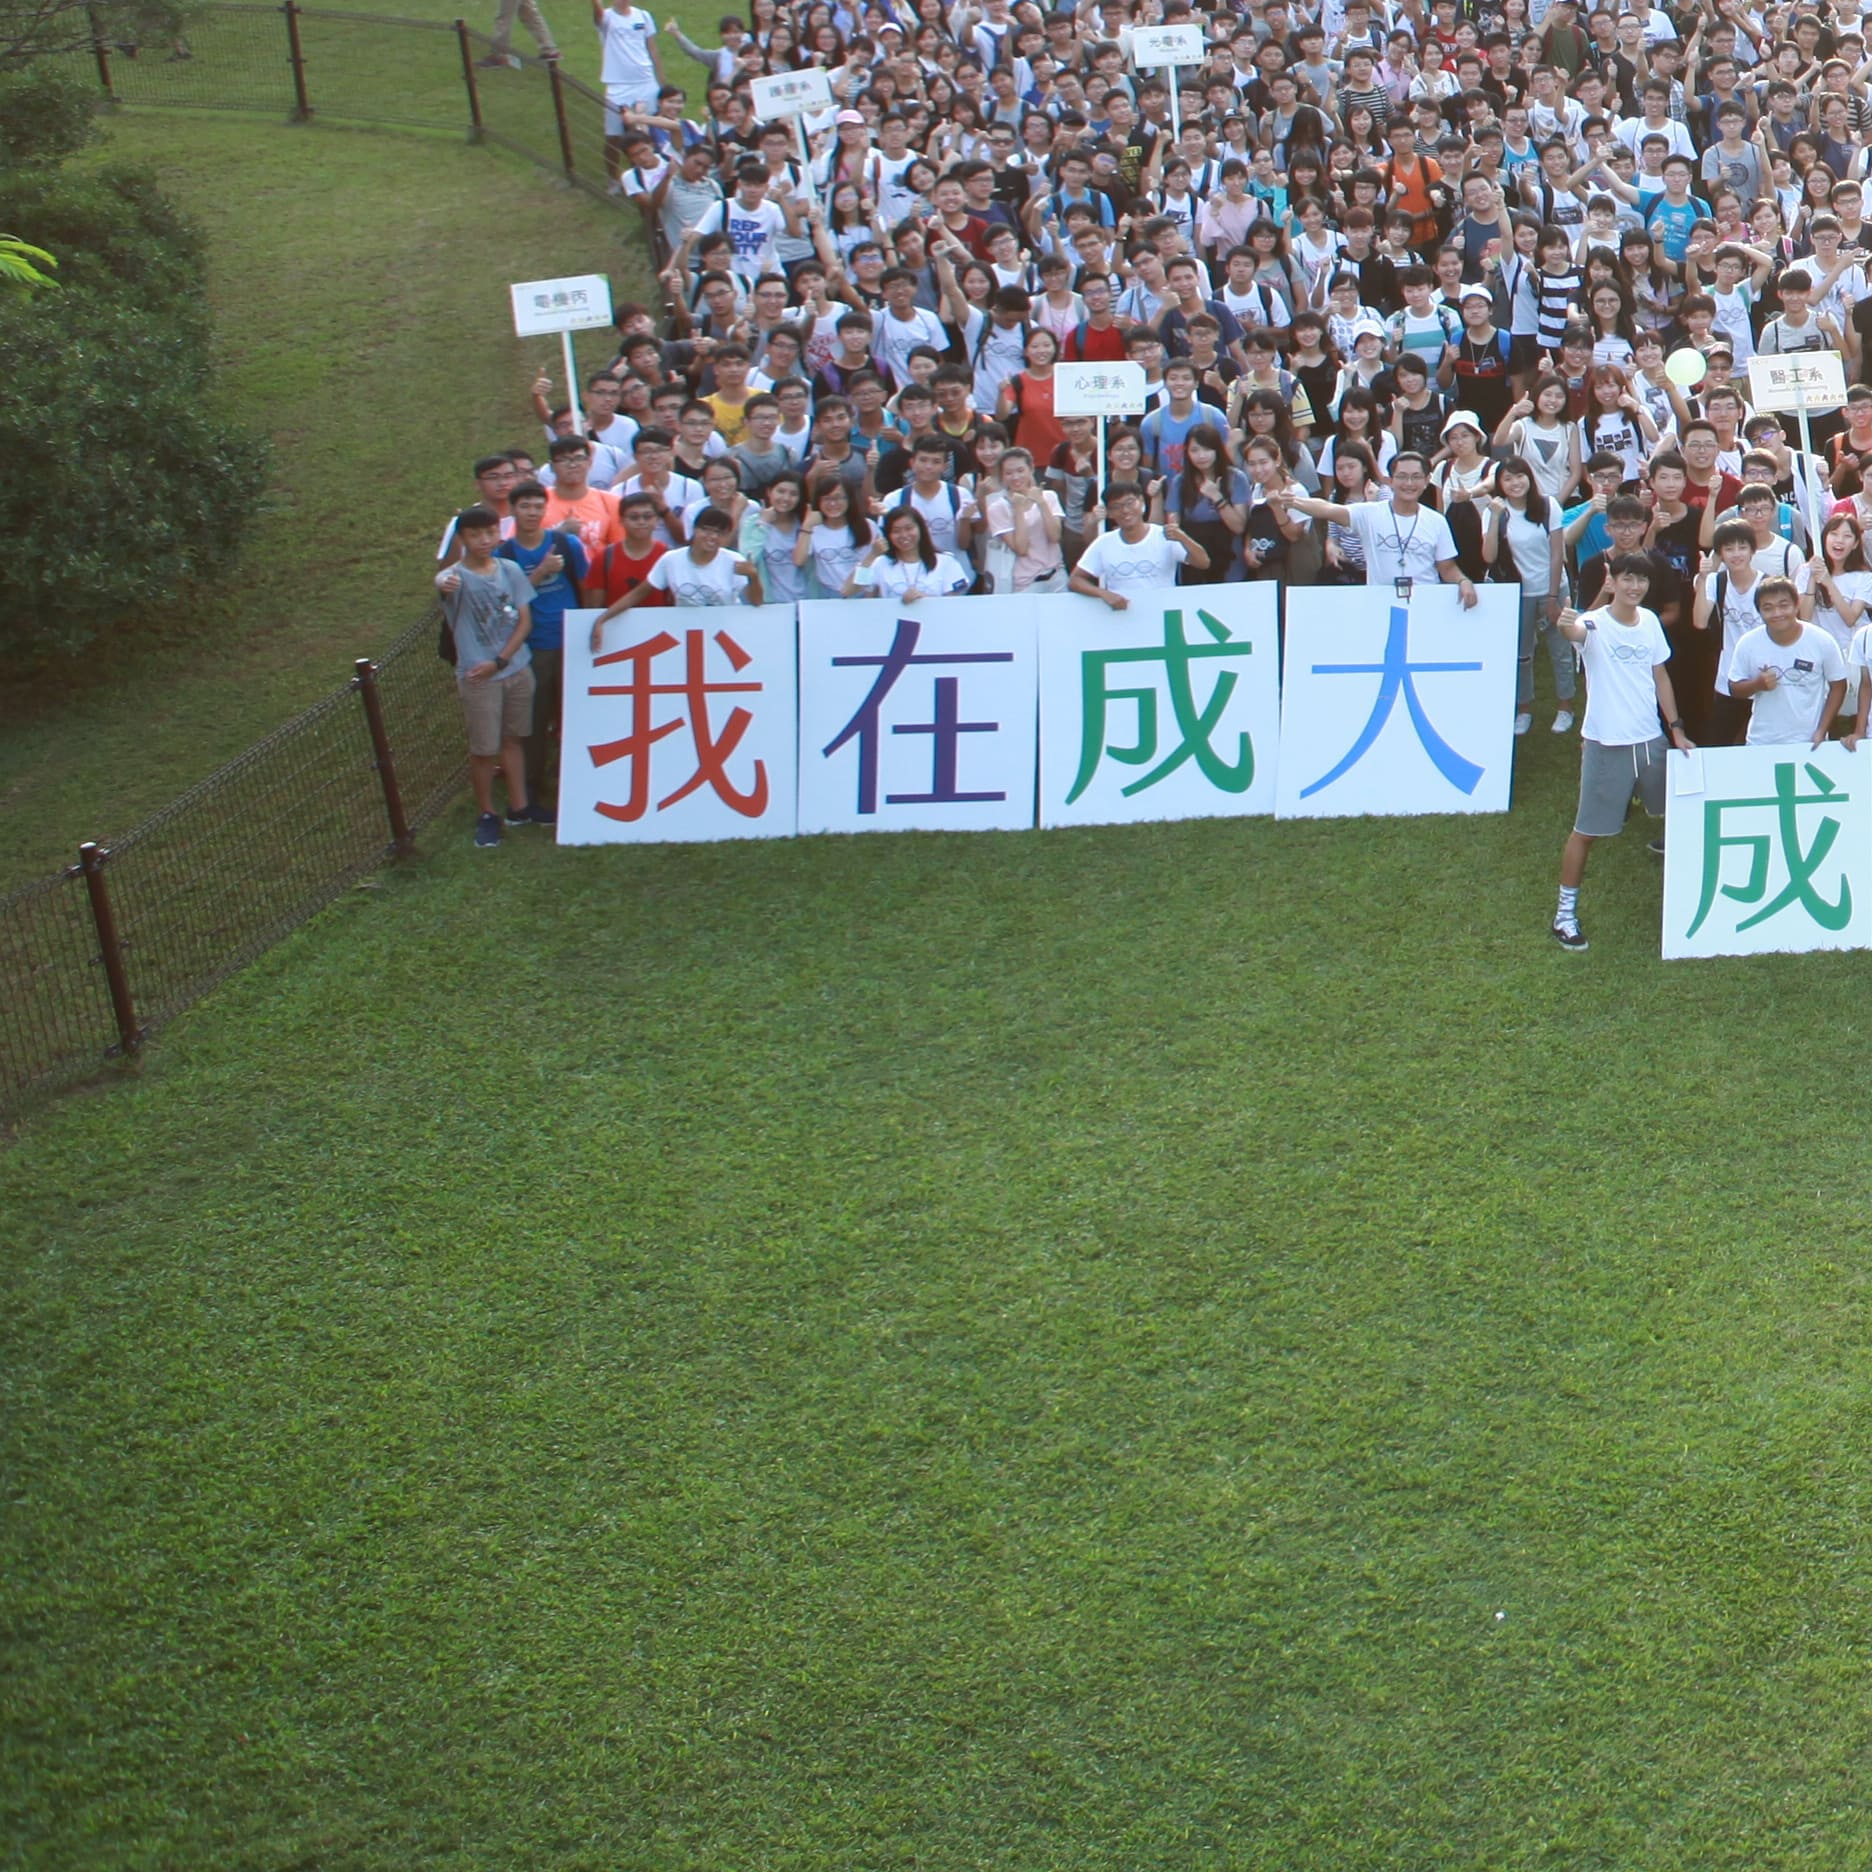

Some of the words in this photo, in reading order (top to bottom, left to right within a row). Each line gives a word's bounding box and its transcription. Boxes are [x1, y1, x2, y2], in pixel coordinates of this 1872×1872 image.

[1149, 35, 1187, 48] 光電系
[730, 219, 761, 232] REP
[533, 289, 589, 309] 電機丙
[1074, 375, 1126, 391] 心理系
[1769, 366, 1824, 385] 醫工系
[1686, 762, 1853, 940] 成
